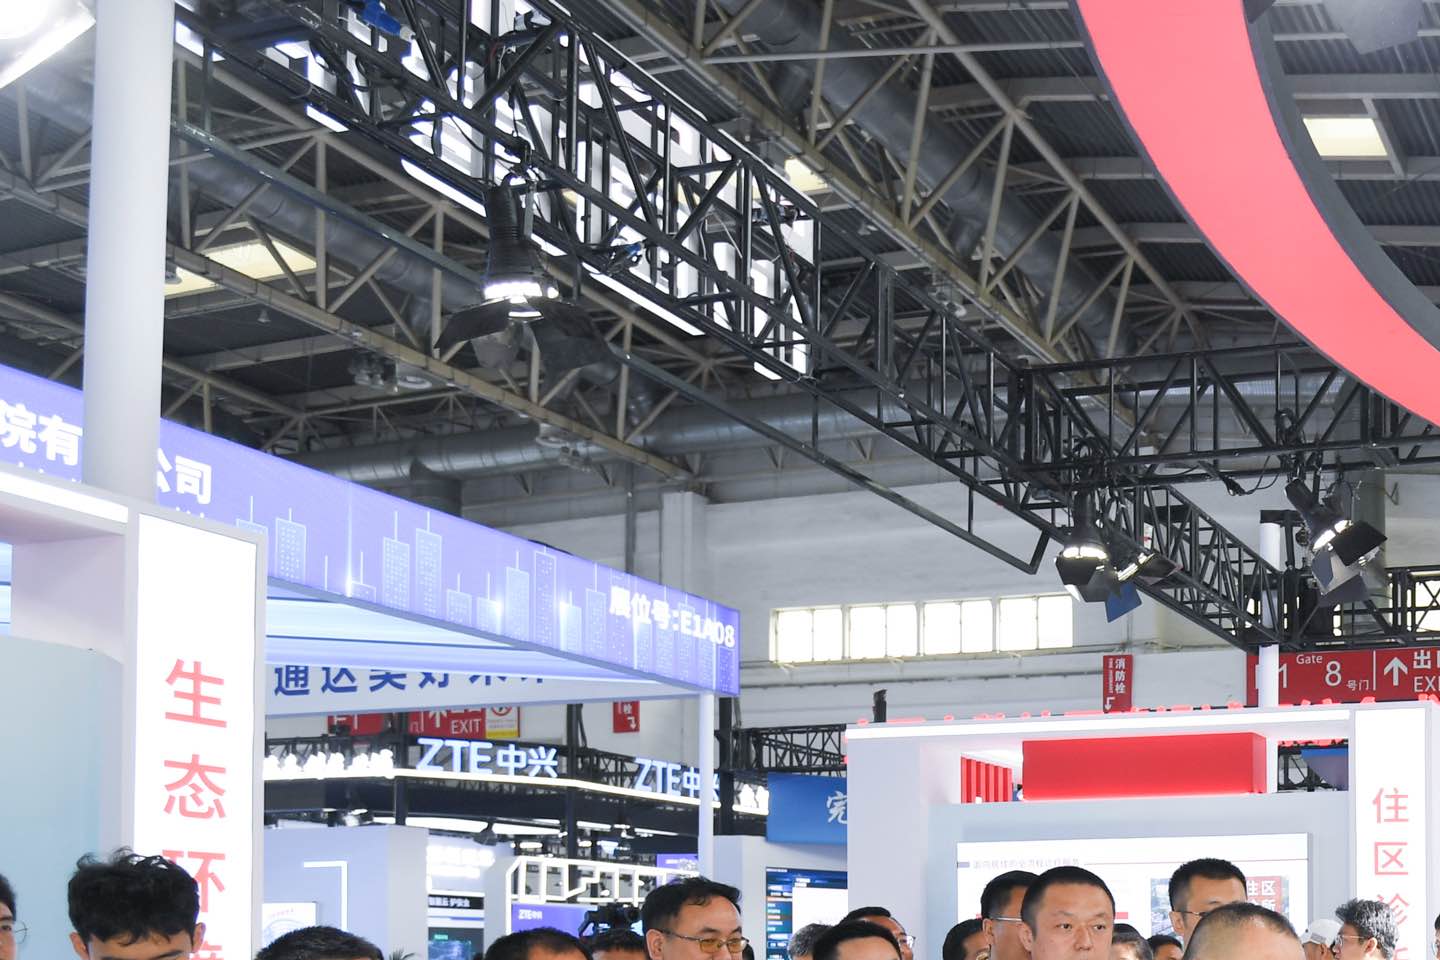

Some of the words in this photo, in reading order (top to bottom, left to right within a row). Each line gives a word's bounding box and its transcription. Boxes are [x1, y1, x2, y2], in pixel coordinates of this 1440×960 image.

[1296, 652, 1323, 665] Gate
[1324, 660, 1342, 687] 8
[1346, 679, 1370, 691] 号门
[451, 718, 481, 735] EXIT
